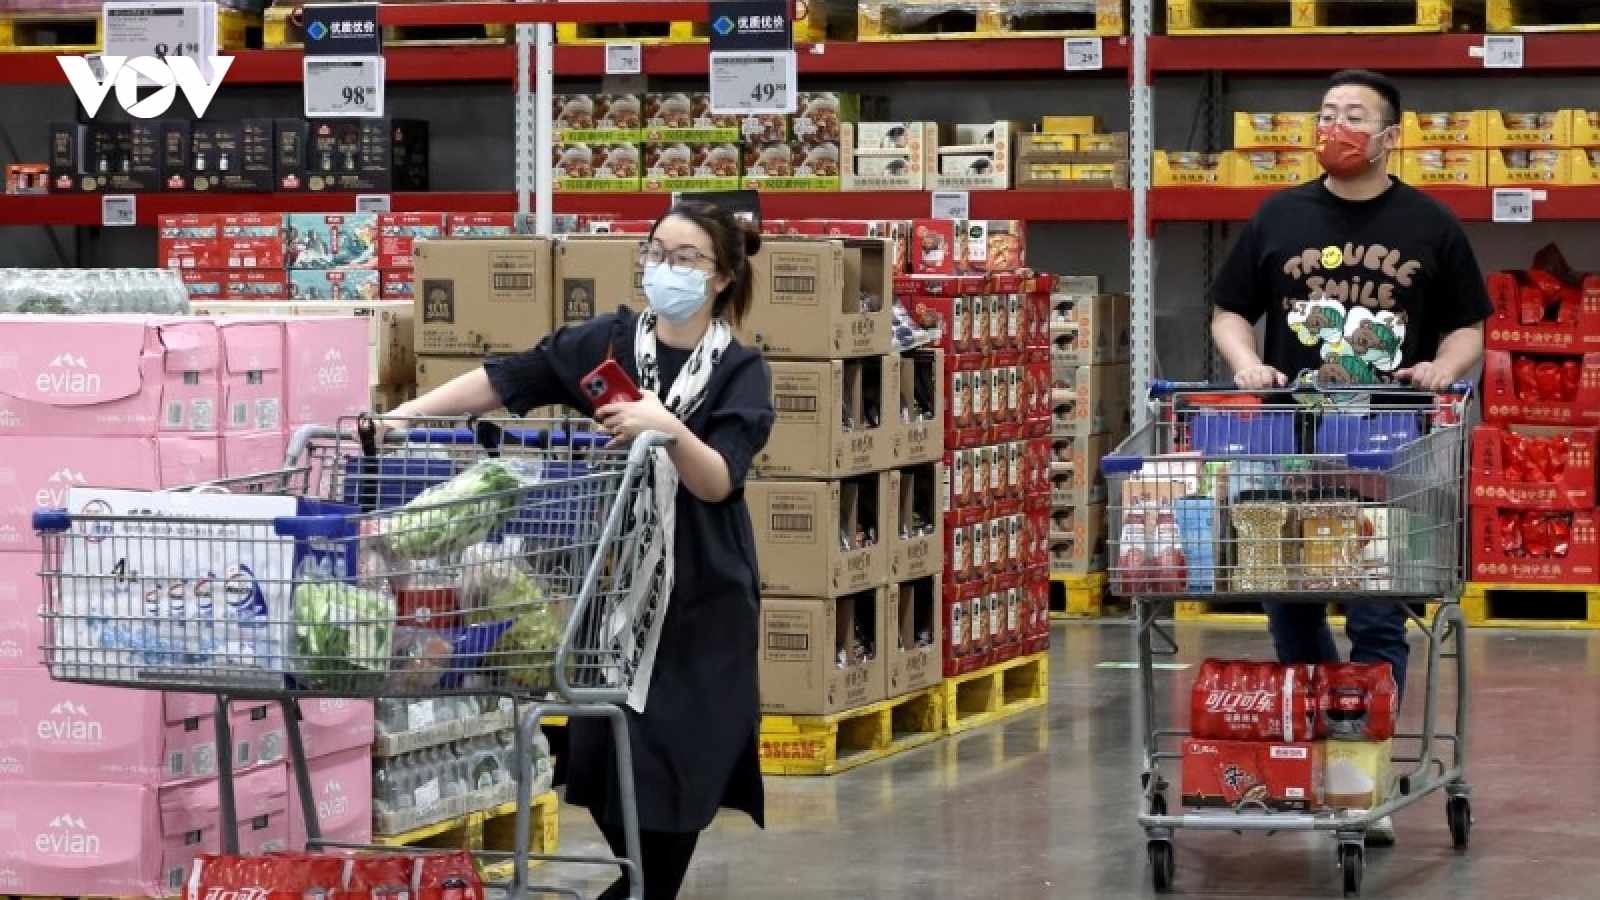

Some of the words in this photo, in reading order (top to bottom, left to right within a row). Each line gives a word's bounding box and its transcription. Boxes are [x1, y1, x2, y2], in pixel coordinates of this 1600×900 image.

[751, 82, 775, 102] 49
[1305, 276, 1397, 309] SMILE
[36, 371, 100, 393] evian
[36, 485, 70, 506] evi
[37, 716, 103, 741] evian
[35, 831, 100, 855] evian
